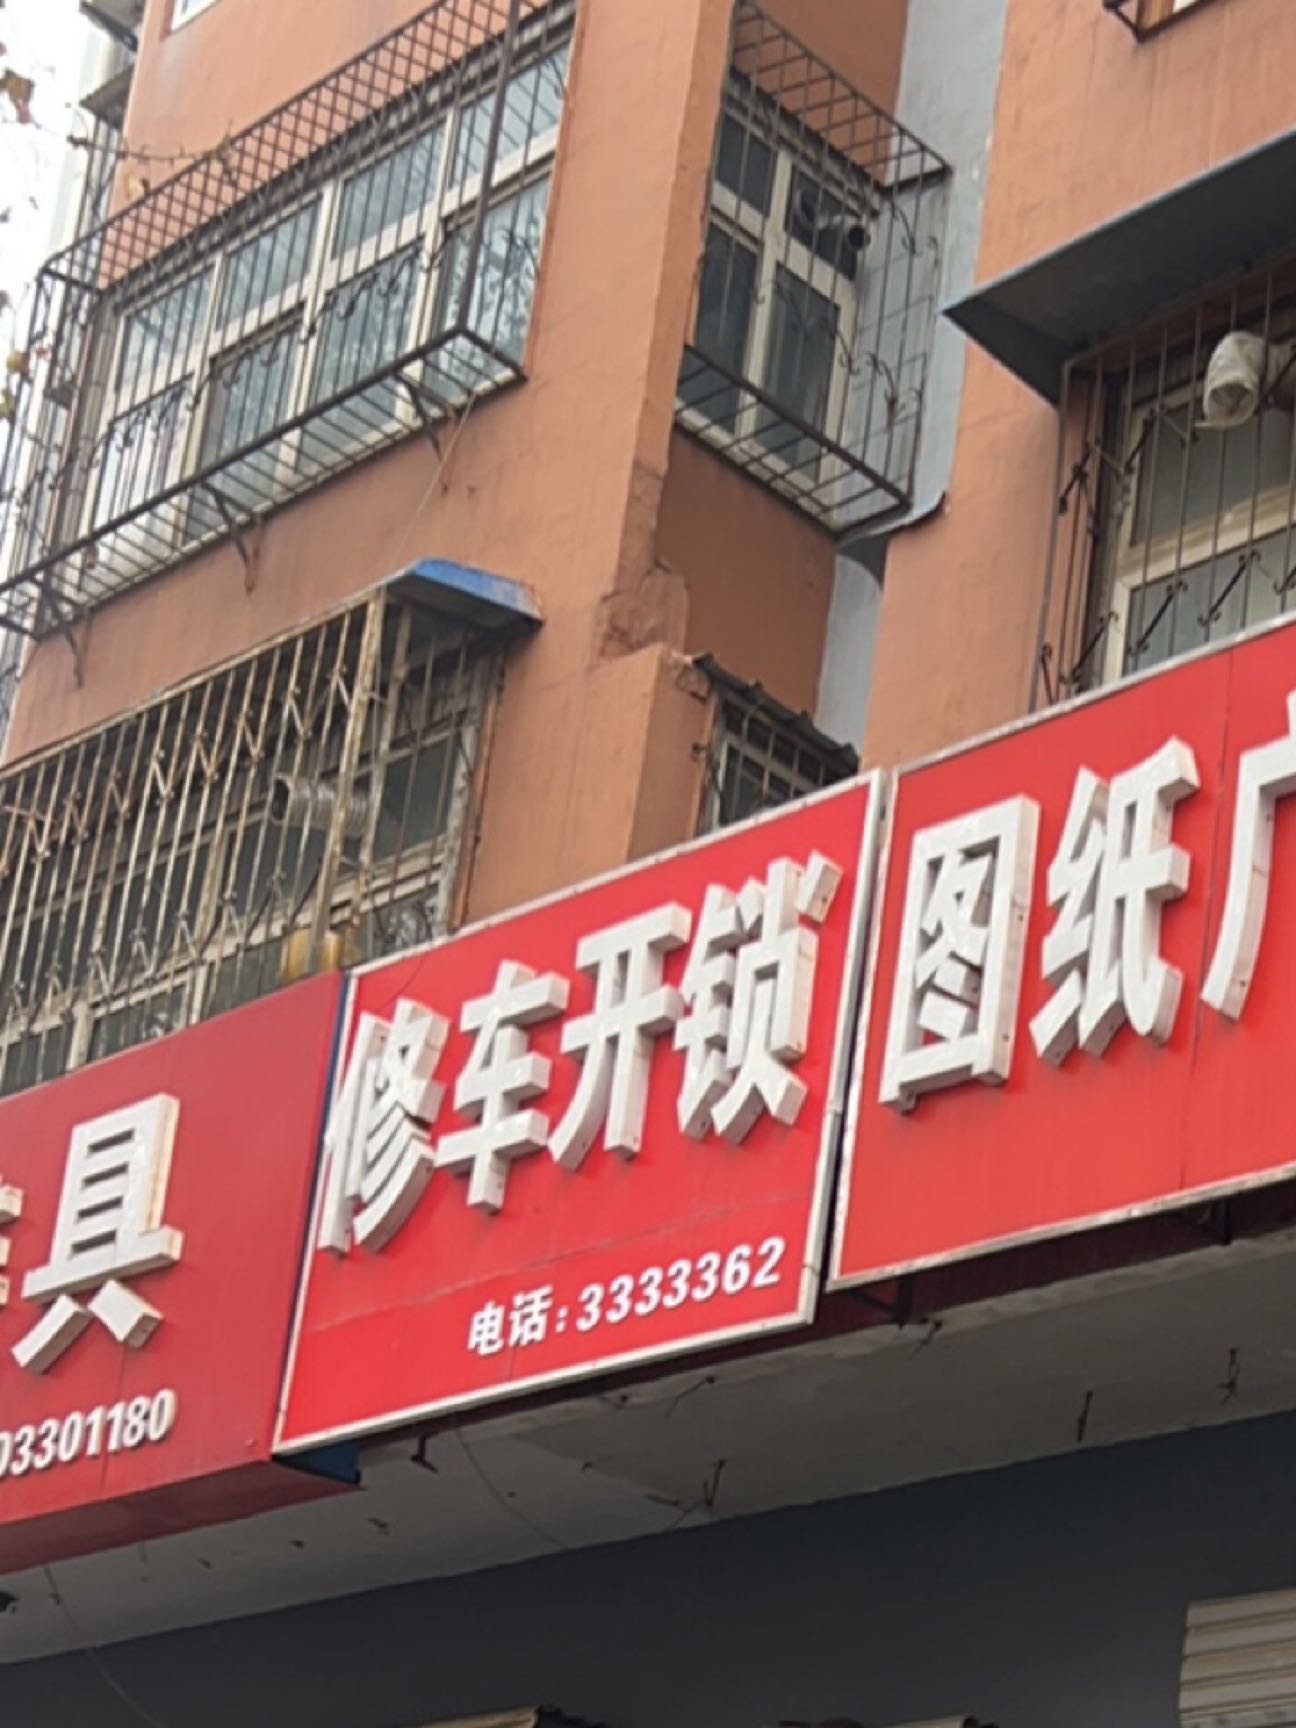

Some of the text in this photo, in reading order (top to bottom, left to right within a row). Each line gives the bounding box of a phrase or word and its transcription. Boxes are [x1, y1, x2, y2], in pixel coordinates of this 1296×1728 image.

[317, 850, 842, 1258] 修车开锁
[0, 1092, 184, 1375] 具
